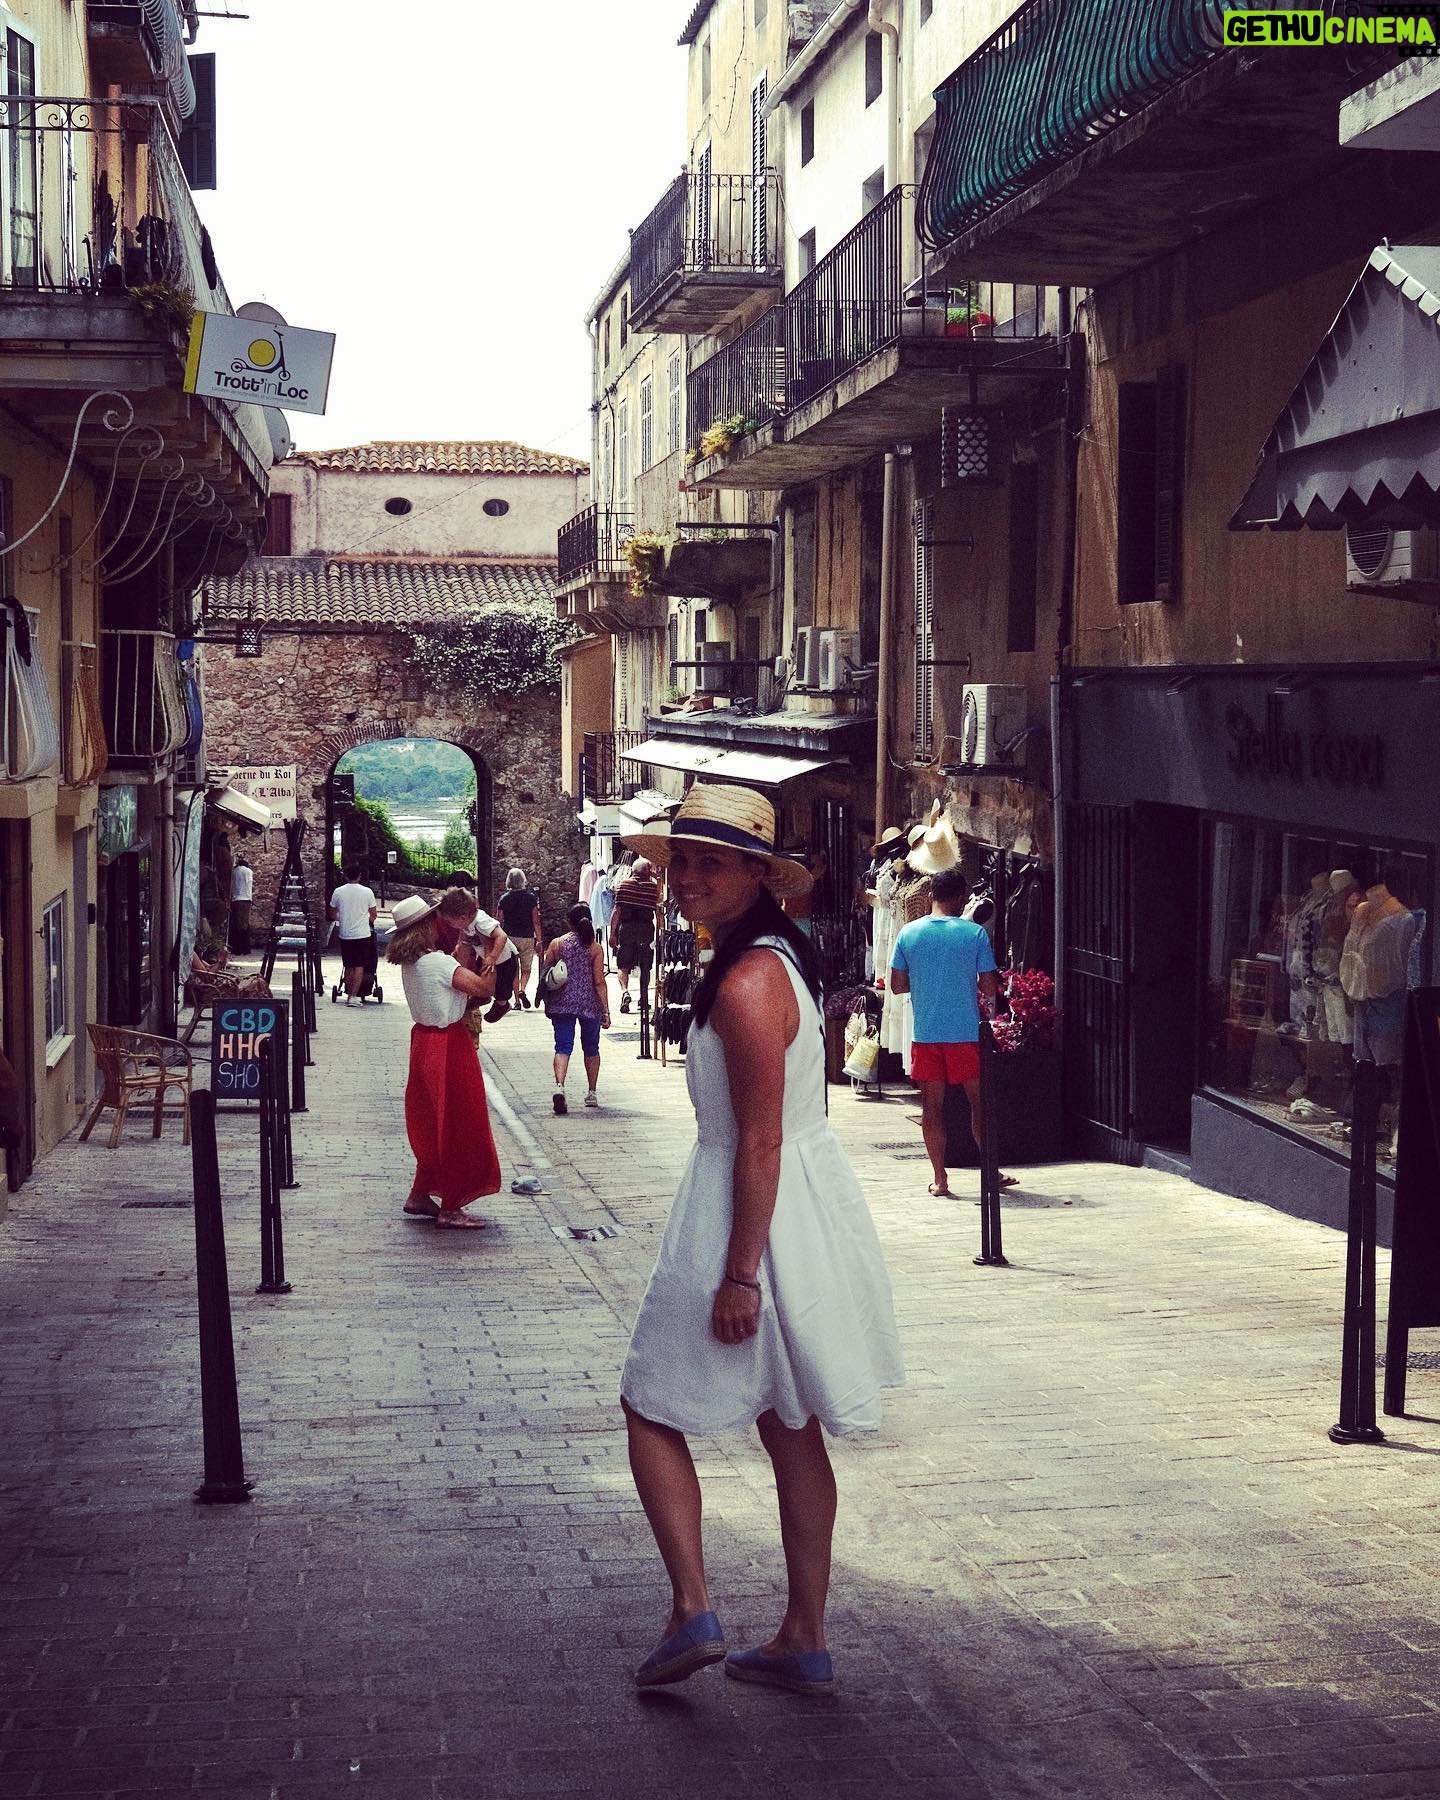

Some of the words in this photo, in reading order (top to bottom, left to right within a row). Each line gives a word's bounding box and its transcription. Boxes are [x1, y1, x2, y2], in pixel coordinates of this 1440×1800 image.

[260, 770, 271, 779] du
[274, 768, 291, 779] Roi
[221, 1008, 276, 1033] CBD
[220, 1032, 272, 1060] HHC
[217, 1061, 260, 1089] SHO
